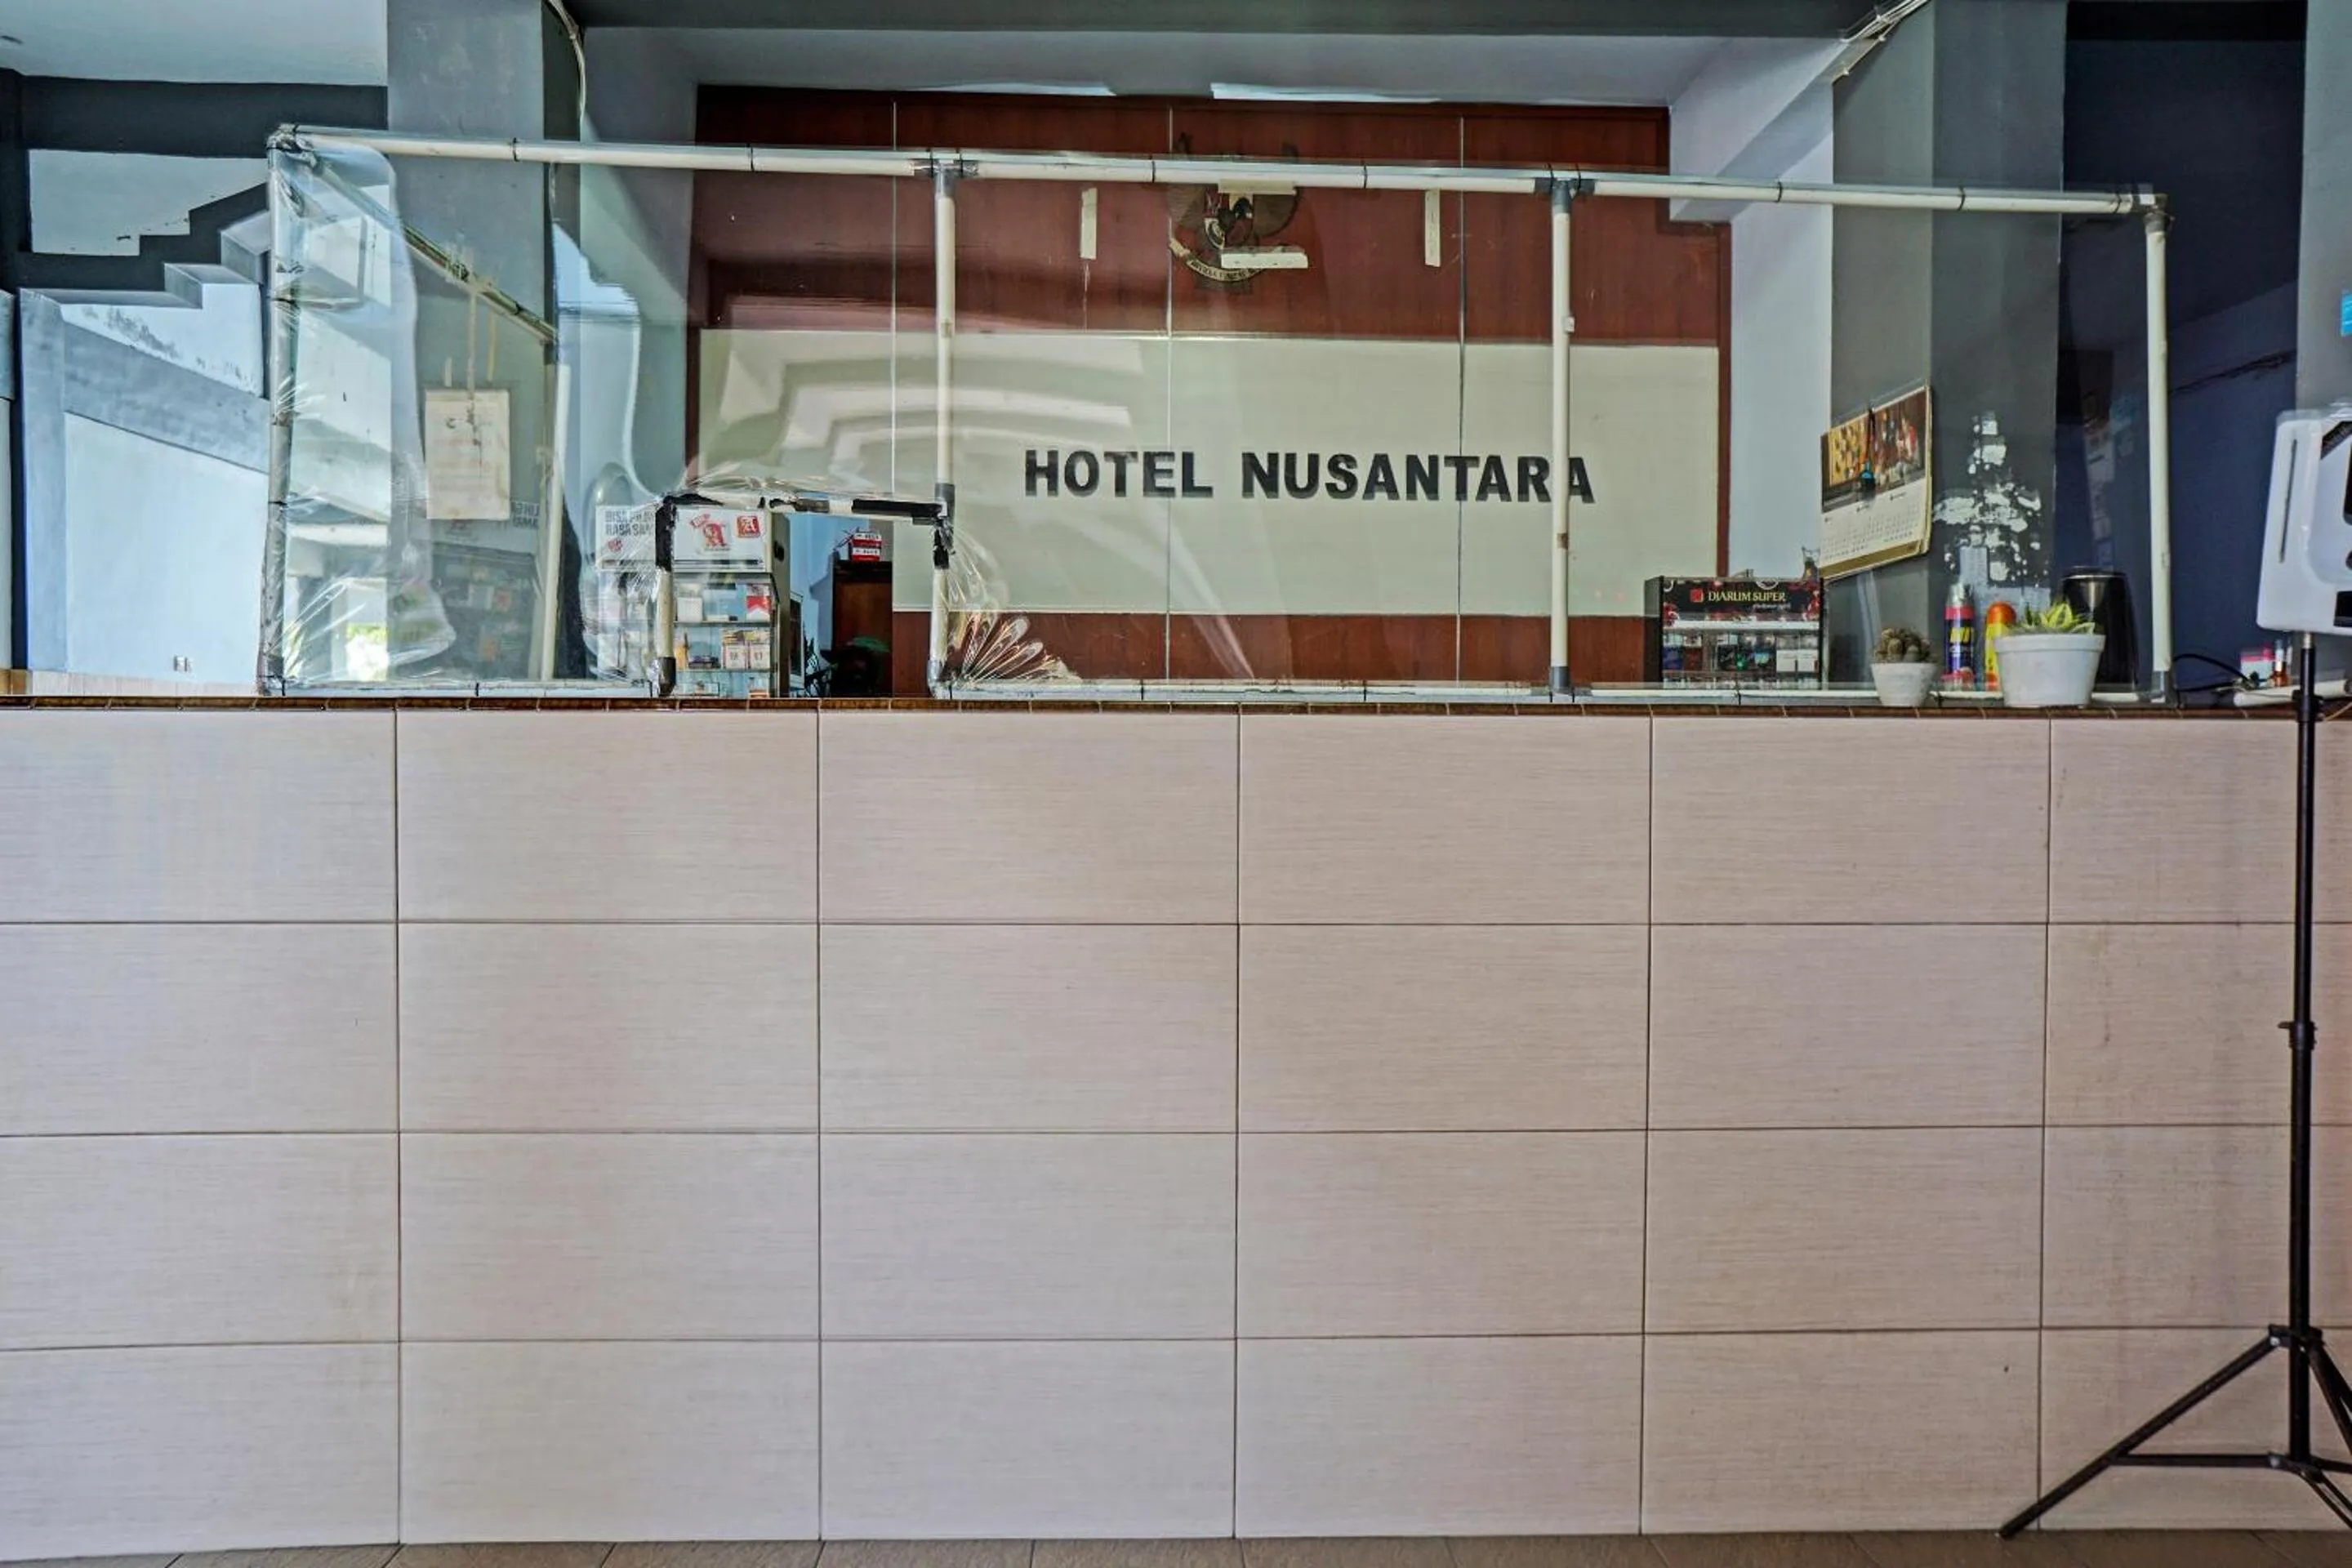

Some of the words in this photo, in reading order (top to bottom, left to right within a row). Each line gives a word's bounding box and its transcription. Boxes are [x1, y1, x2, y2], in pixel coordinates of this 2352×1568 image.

[1025, 449, 1214, 498] HOTEL
[1241, 452, 1595, 503] NUSANTARA
[1708, 590, 1751, 602] DJARUM
[1752, 590, 1786, 602] SUPER
